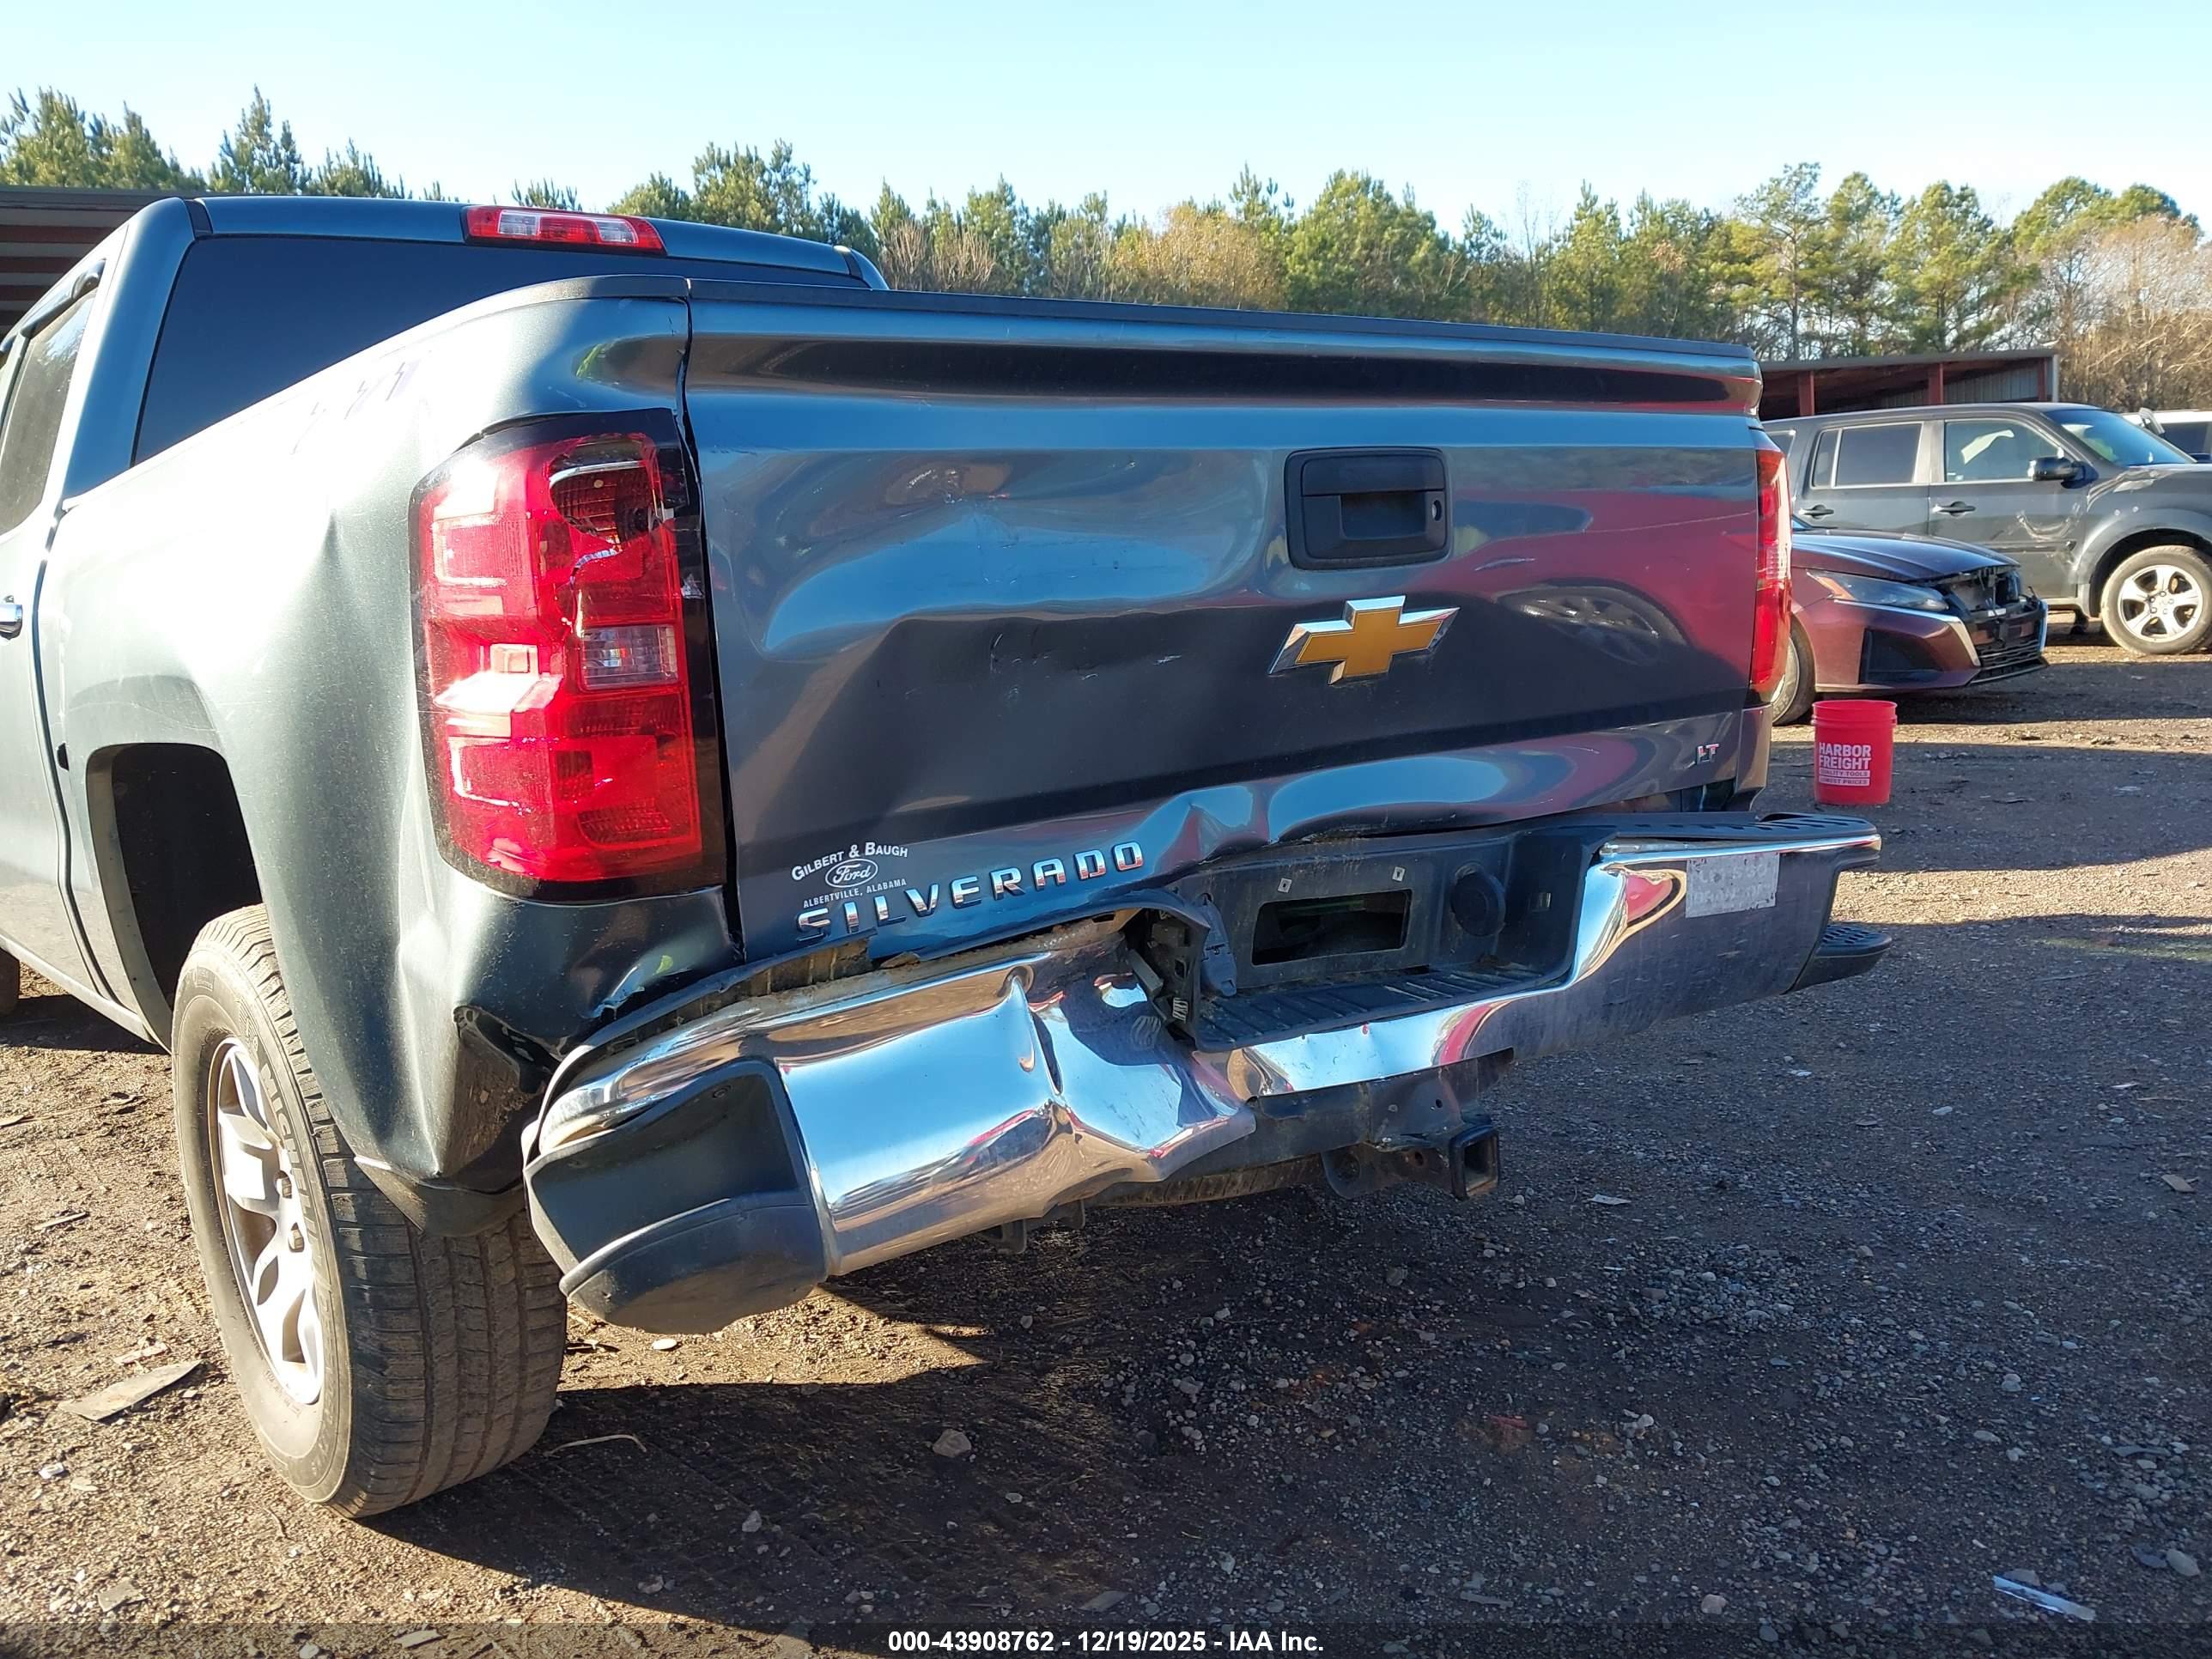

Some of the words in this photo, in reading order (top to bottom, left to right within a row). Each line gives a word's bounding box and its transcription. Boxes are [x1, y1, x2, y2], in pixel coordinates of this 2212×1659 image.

[1697, 744, 1719, 764] LT
[1819, 742, 1872, 757] HARBOR
[1819, 755, 1872, 769] FREIGHT
[792, 851, 844, 881] GILBERT
[848, 844, 860, 859] &
[865, 842, 908, 858] BAUGH
[832, 862, 872, 884] Ford
[797, 841, 1146, 941] SILVERADO
[803, 887, 863, 908] ALBERTVILLE,
[866, 878, 907, 893] ALABAMA
